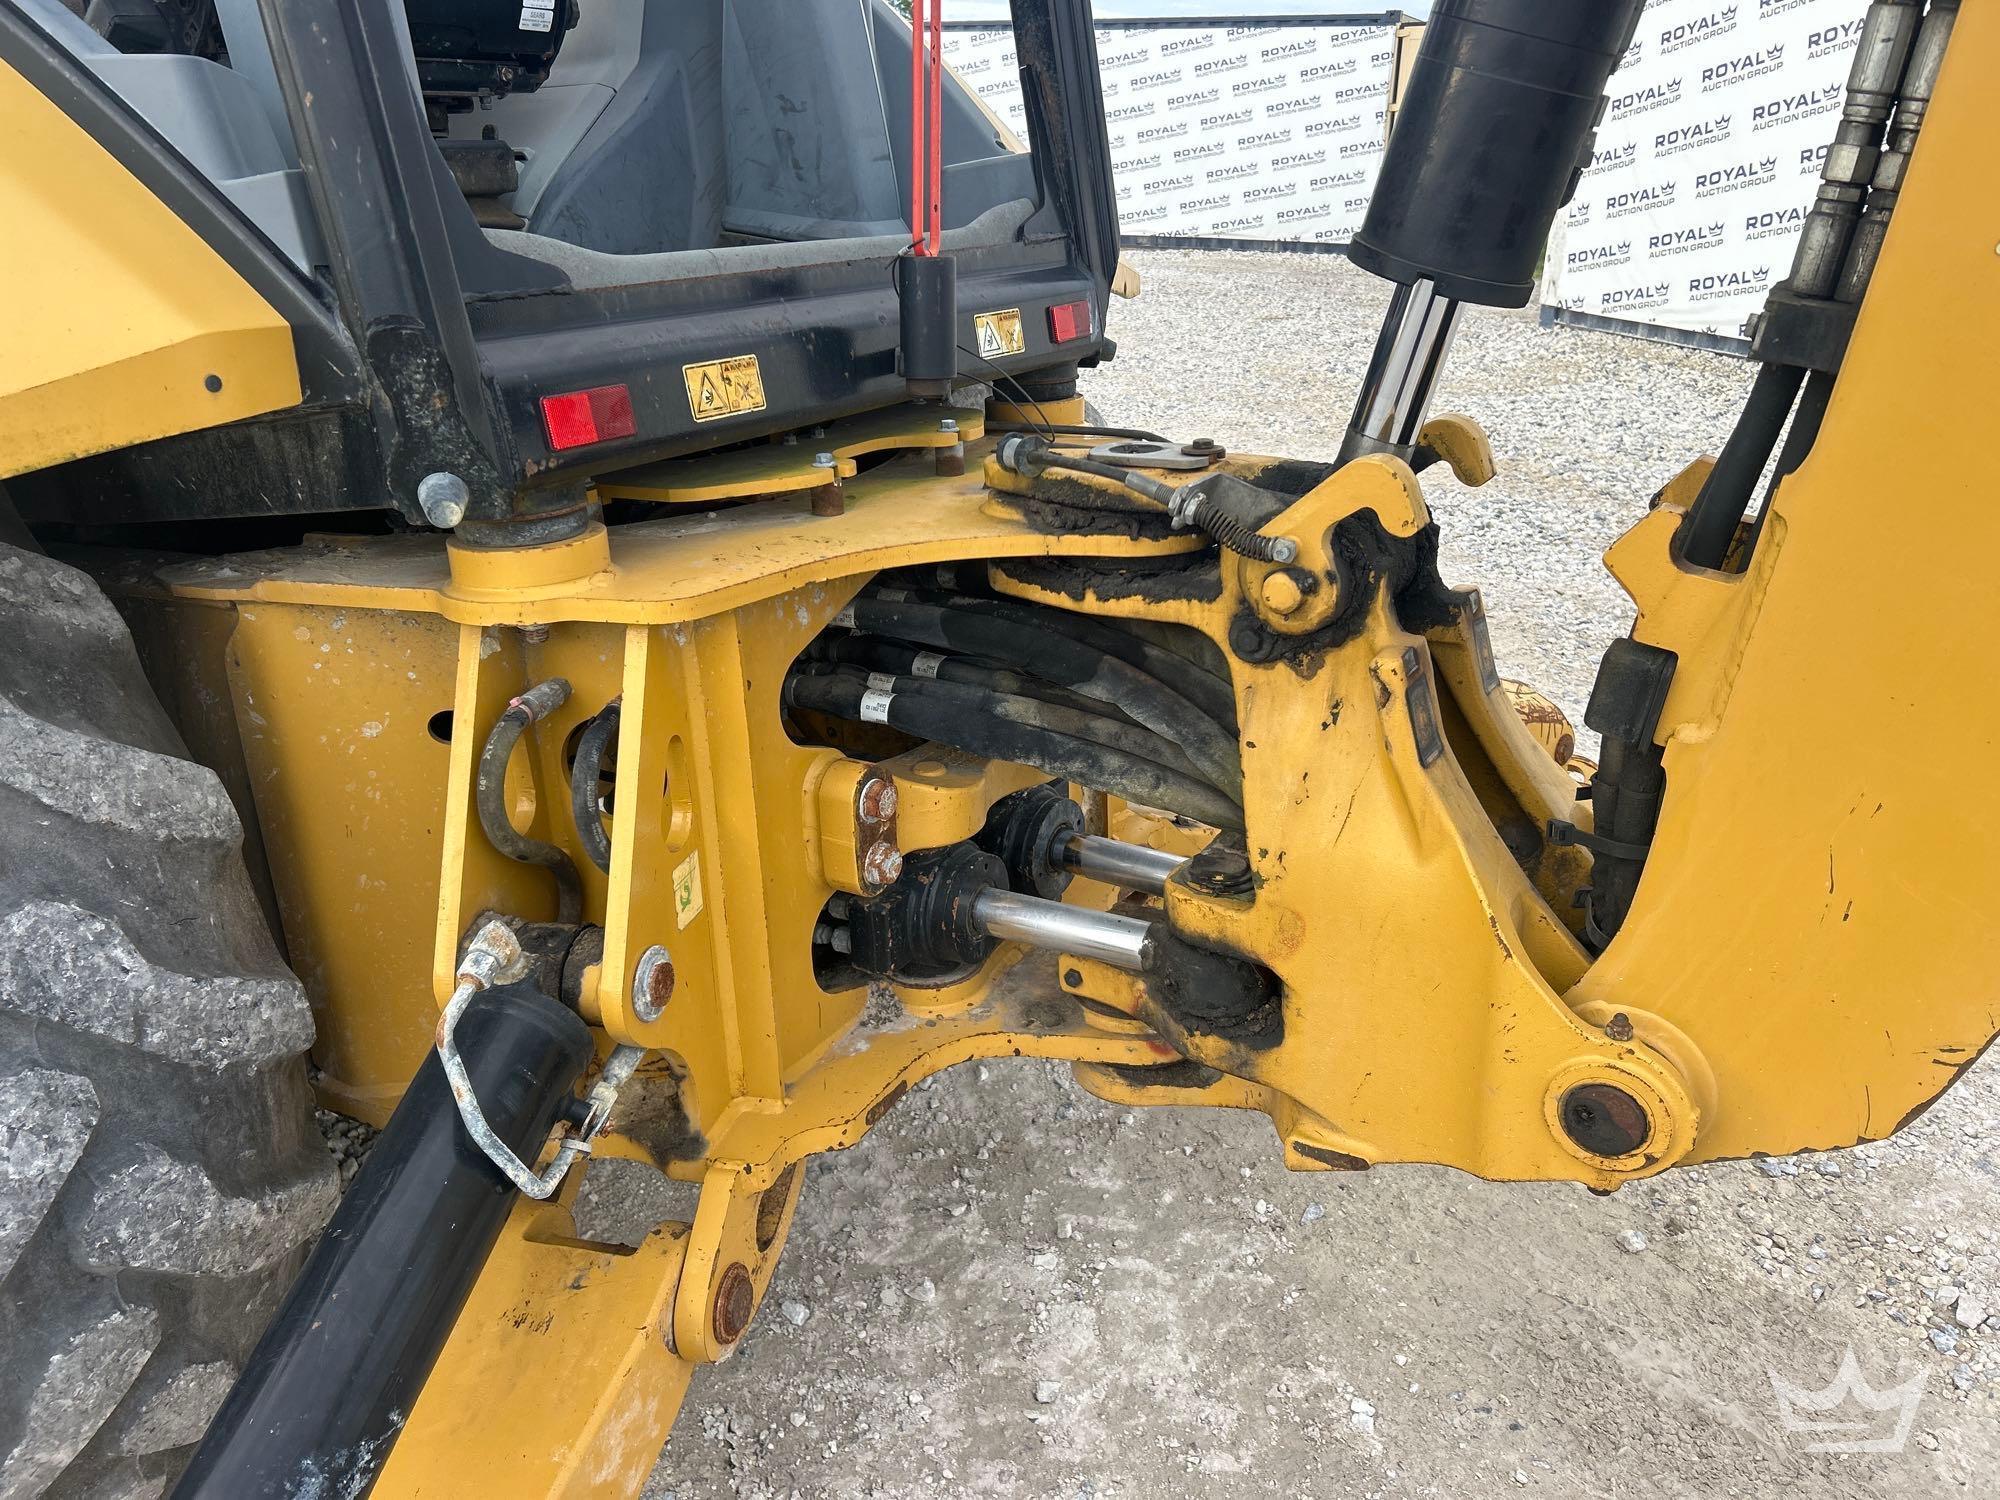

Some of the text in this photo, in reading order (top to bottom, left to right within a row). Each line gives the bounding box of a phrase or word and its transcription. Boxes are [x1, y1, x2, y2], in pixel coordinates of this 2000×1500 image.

[1760, 0, 1806, 20] AUCTION
[1331, 27, 1375, 42] ROYAL
[1661, 14, 1720, 45] ROYAL
[1808, 18, 1866, 49] ROYA
[1161, 37, 1201, 52] ROYAL
[1661, 22, 1736, 56] AUCTION GROUP
[1262, 43, 1304, 57] ROYAL
[1808, 38, 1858, 60] AUCTION
[1099, 52, 1138, 65] ROYAL
[1195, 58, 1236, 72] ROYAL
[1617, 57, 1642, 70] ROUP
[1301, 63, 1344, 77] ROYAL
[1702, 52, 1765, 82] ROYAL
[1131, 73, 1170, 86] ROYAL
[1702, 62, 1783, 93] AUCTION GROUP
[978, 80, 1015, 93] ROYAL
[1233, 78, 1274, 92] ROYAL
[1336, 84, 1380, 98] ROYAL
[1168, 92, 1208, 105] ROYAL
[1267, 98, 1309, 112] ROYAL
[1612, 85, 1666, 112] ROYAL
[1106, 105, 1144, 118] ROYAL
[1612, 94, 1681, 121] AUCTION GROUP
[1753, 91, 1821, 121] ROYAL
[1201, 112, 1241, 126] ROYAL
[1752, 102, 1841, 132] AUCTION GROUP
[1138, 126, 1176, 139] ROYAL
[1305, 119, 1348, 132] ROYAL
[1238, 132, 1279, 145] ROYAL
[1655, 122, 1713, 148] ROYAL
[1174, 145, 1214, 158] ROYAL
[1340, 140, 1382, 154] ROYAL
[1655, 132, 1730, 159] AUCTION GROUP
[1272, 153, 1314, 166] ROYAL
[1594, 148, 1621, 165] YAL
[1113, 158, 1150, 170] ROYAL
[1608, 158, 1635, 172] GROUP
[1207, 165, 1246, 178] ROYAL
[1696, 163, 1758, 188] ROYAL
[1144, 178, 1182, 190] ROYAL
[1310, 174, 1353, 186] ROYAL
[1696, 174, 1776, 199] AUCTION GROUP
[1244, 186, 1284, 198] ROYAL
[1607, 187, 1659, 209] ROYAL
[1180, 197, 1219, 210] ROYAL
[1345, 196, 1370, 207] ROY
[1119, 209, 1157, 220] ROYAL
[1277, 207, 1319, 219] ROYAL
[1606, 198, 1675, 220] AUCTION GROUP
[1212, 218, 1252, 230] ROYAL
[1155, 228, 1188, 238] OYAL
[1315, 227, 1358, 239] ROYAL
[1649, 227, 1706, 249] ROYAL
[1746, 226, 1791, 241] AUCTION
[1568, 245, 1616, 264] ROYAL
[1649, 239, 1724, 259] AUCTION GROUP
[1568, 257, 1630, 273] AUCTION GROUP
[1690, 272, 1751, 291] ROYAL
[1602, 286, 1654, 304] ROYAL
[1689, 285, 1768, 302] AUCTION GROUP
[1602, 298, 1668, 314] AUCTION GROUP
